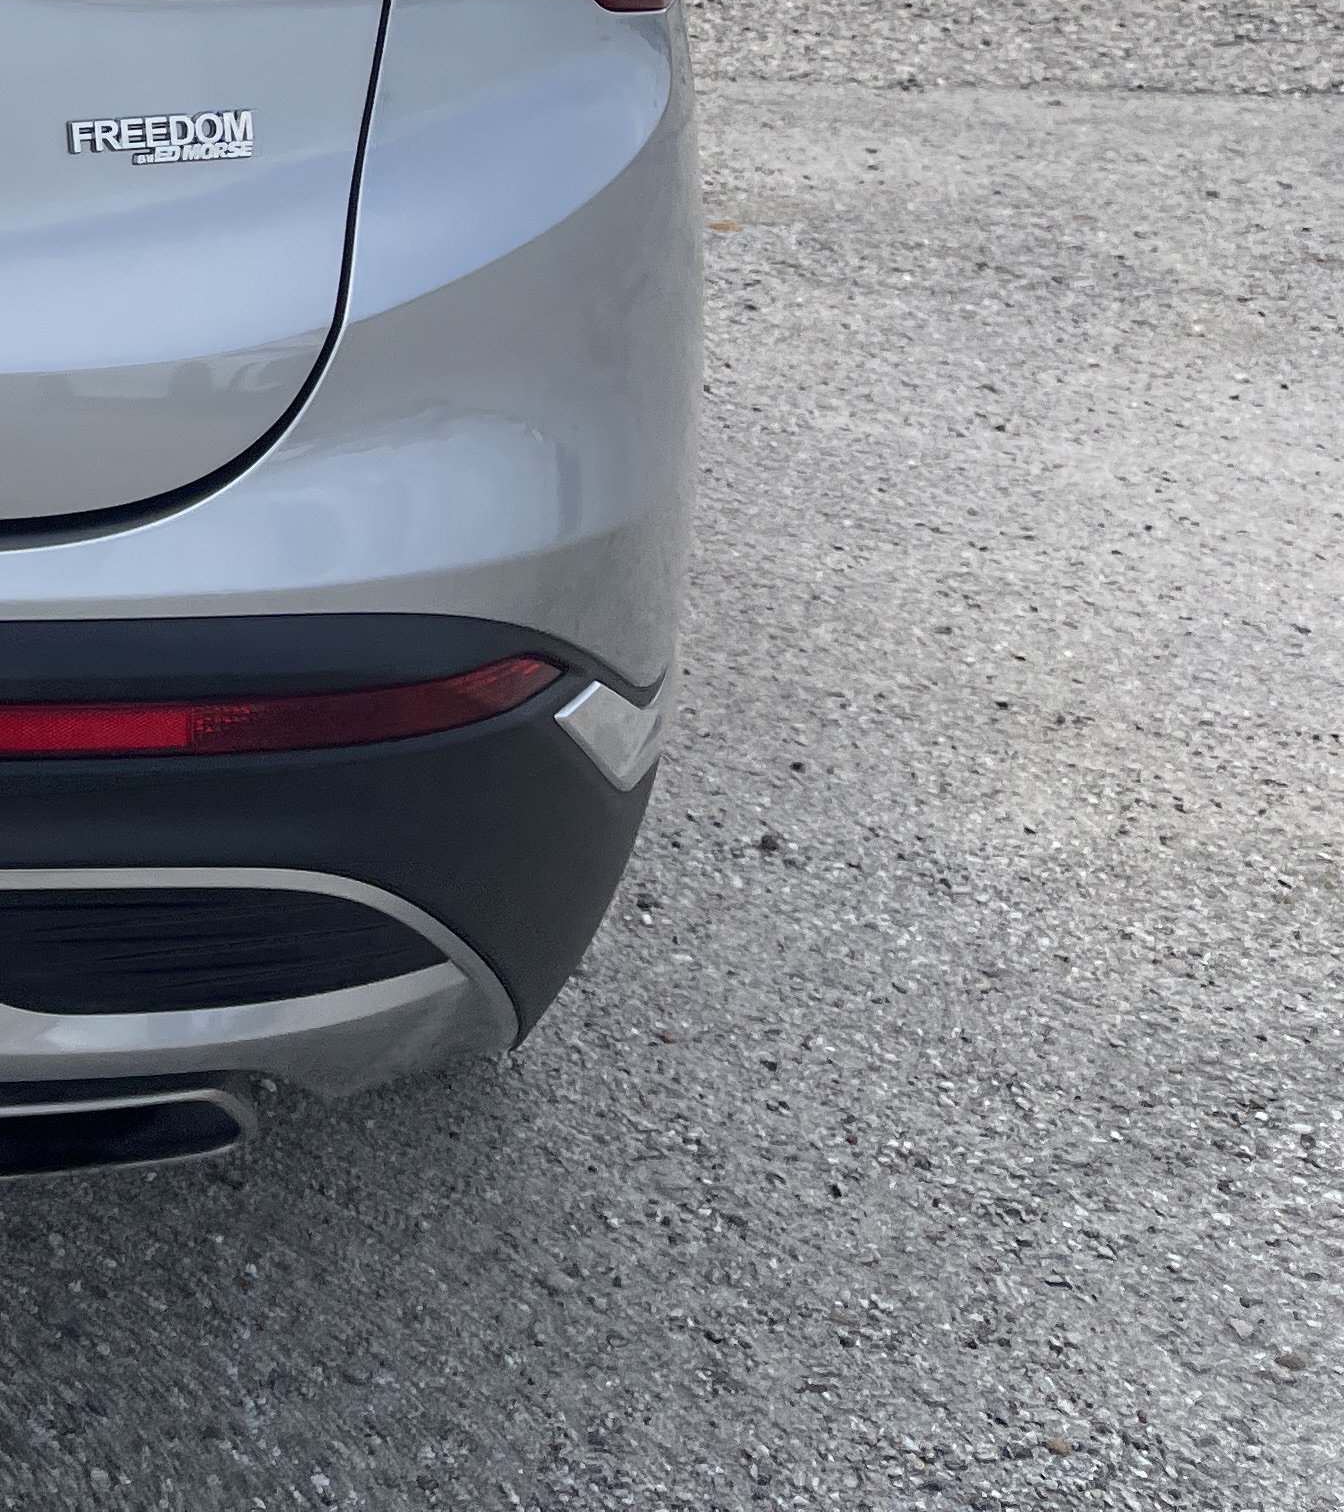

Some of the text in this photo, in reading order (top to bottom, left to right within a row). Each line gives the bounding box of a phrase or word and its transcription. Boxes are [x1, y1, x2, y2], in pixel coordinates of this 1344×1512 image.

[67, 110, 254, 155] FREEDOM
[154, 145, 181, 163] ED
[182, 141, 254, 161] MORSE
